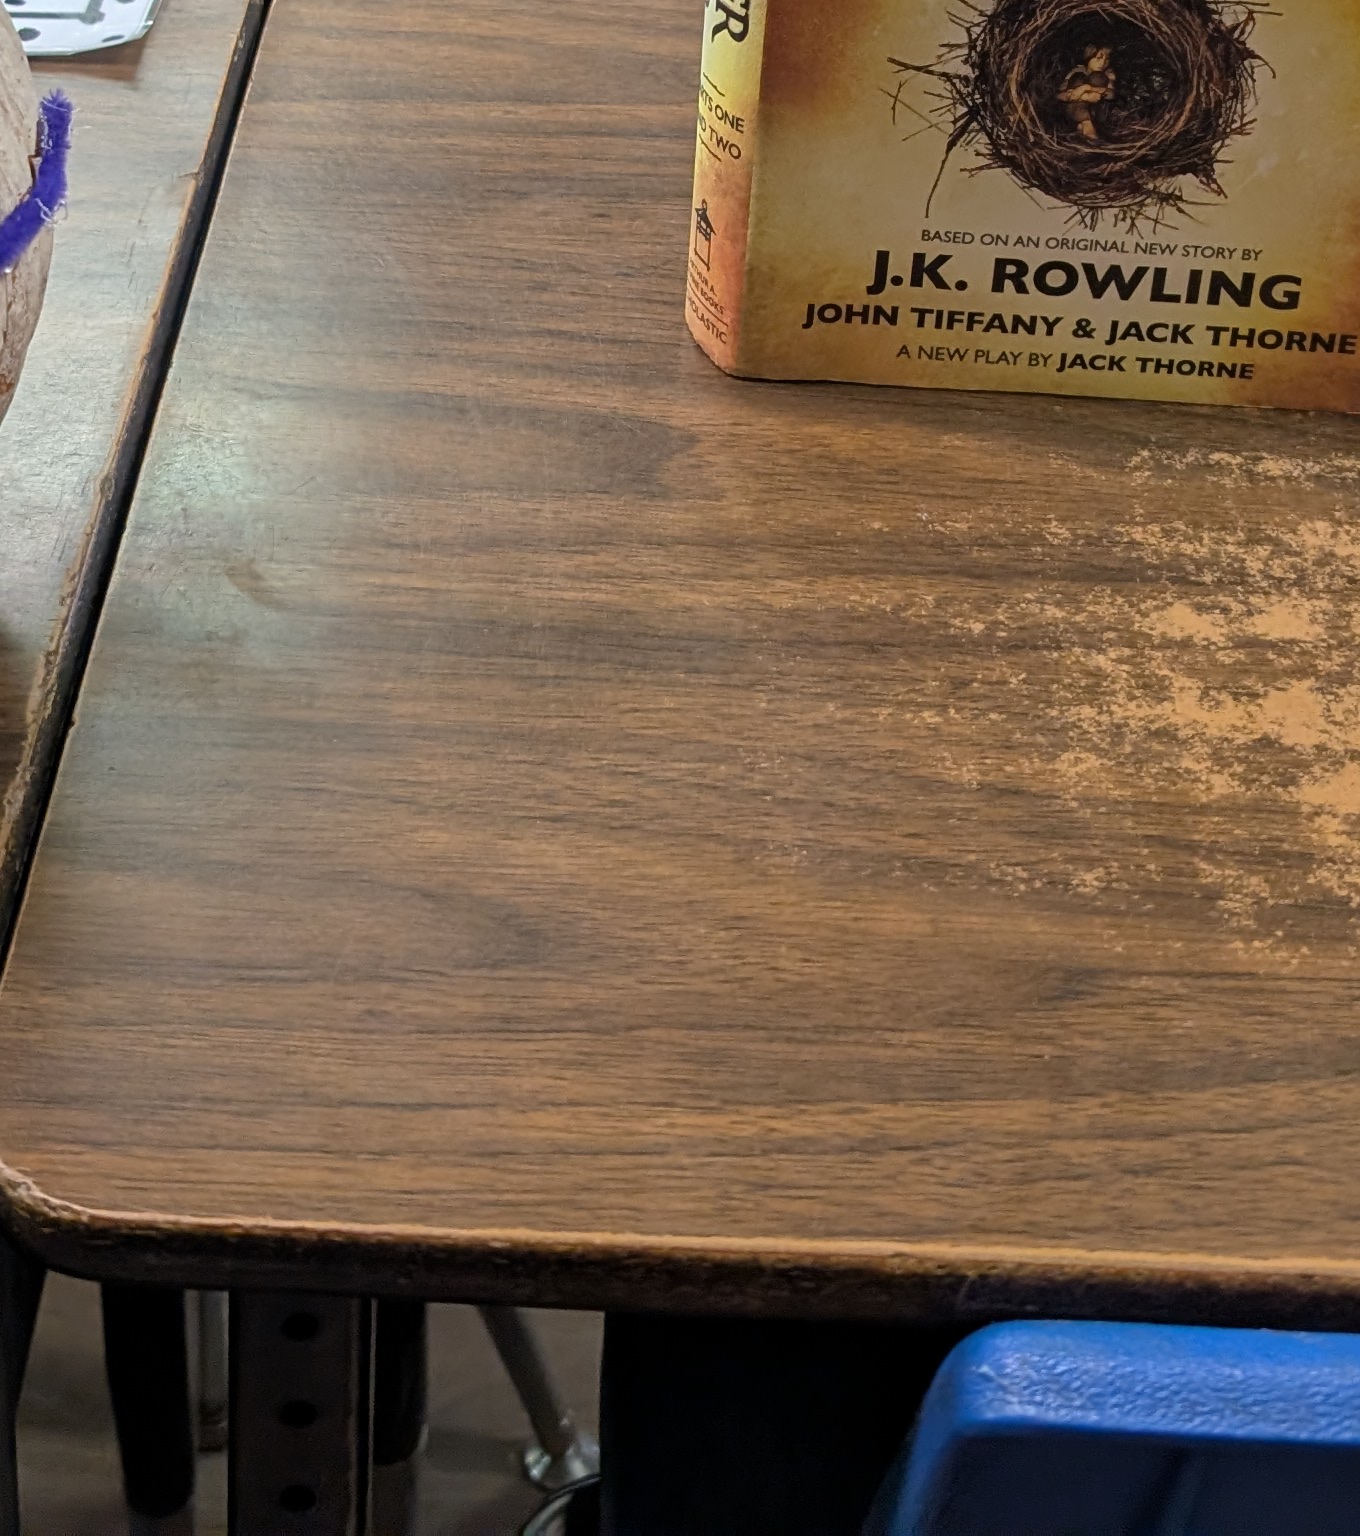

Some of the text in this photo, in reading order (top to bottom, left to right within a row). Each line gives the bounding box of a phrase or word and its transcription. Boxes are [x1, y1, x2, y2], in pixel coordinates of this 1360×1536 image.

[714, 104, 746, 135] ONE
[708, 125, 742, 160] TWO
[921, 229, 1264, 262] BASED ON AN ORIGINAL NEW STORY BY
[865, 249, 1303, 311] J.K. ROWLING
[801, 302, 1359, 356] JOHN TIFFANY & JACK THORNE
[895, 344, 1256, 381] A NEW PLAY BY JACK THORNE
